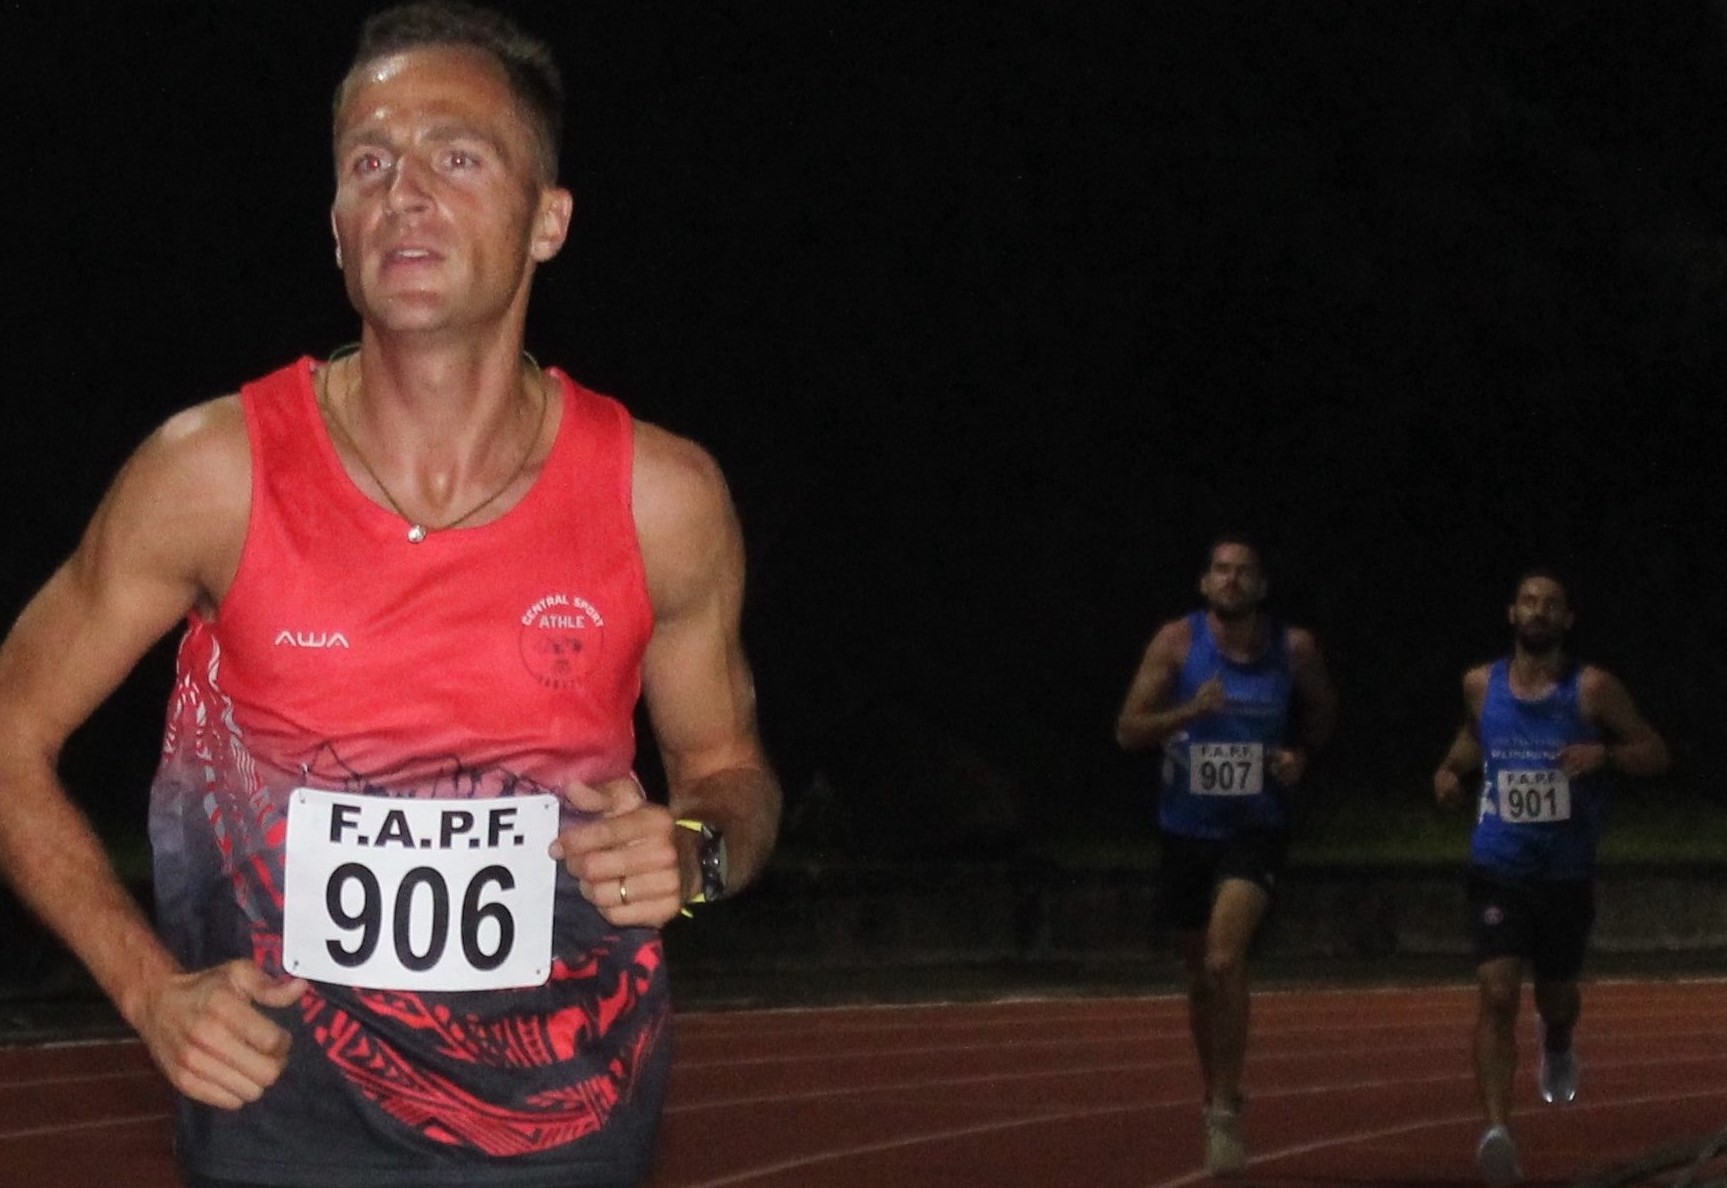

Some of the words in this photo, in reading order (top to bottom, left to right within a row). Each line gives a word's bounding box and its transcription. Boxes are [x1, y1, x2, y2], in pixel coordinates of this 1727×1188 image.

[521, 594, 569, 626] CENTRAL
[573, 597, 605, 627] SPORT
[539, 615, 585, 628] ATHLE
[274, 630, 350, 648] AWA
[1200, 760, 1252, 791] 907
[1508, 788, 1557, 818] 901
[330, 804, 524, 847] F.A.P.F.
[325, 862, 516, 972] 906
